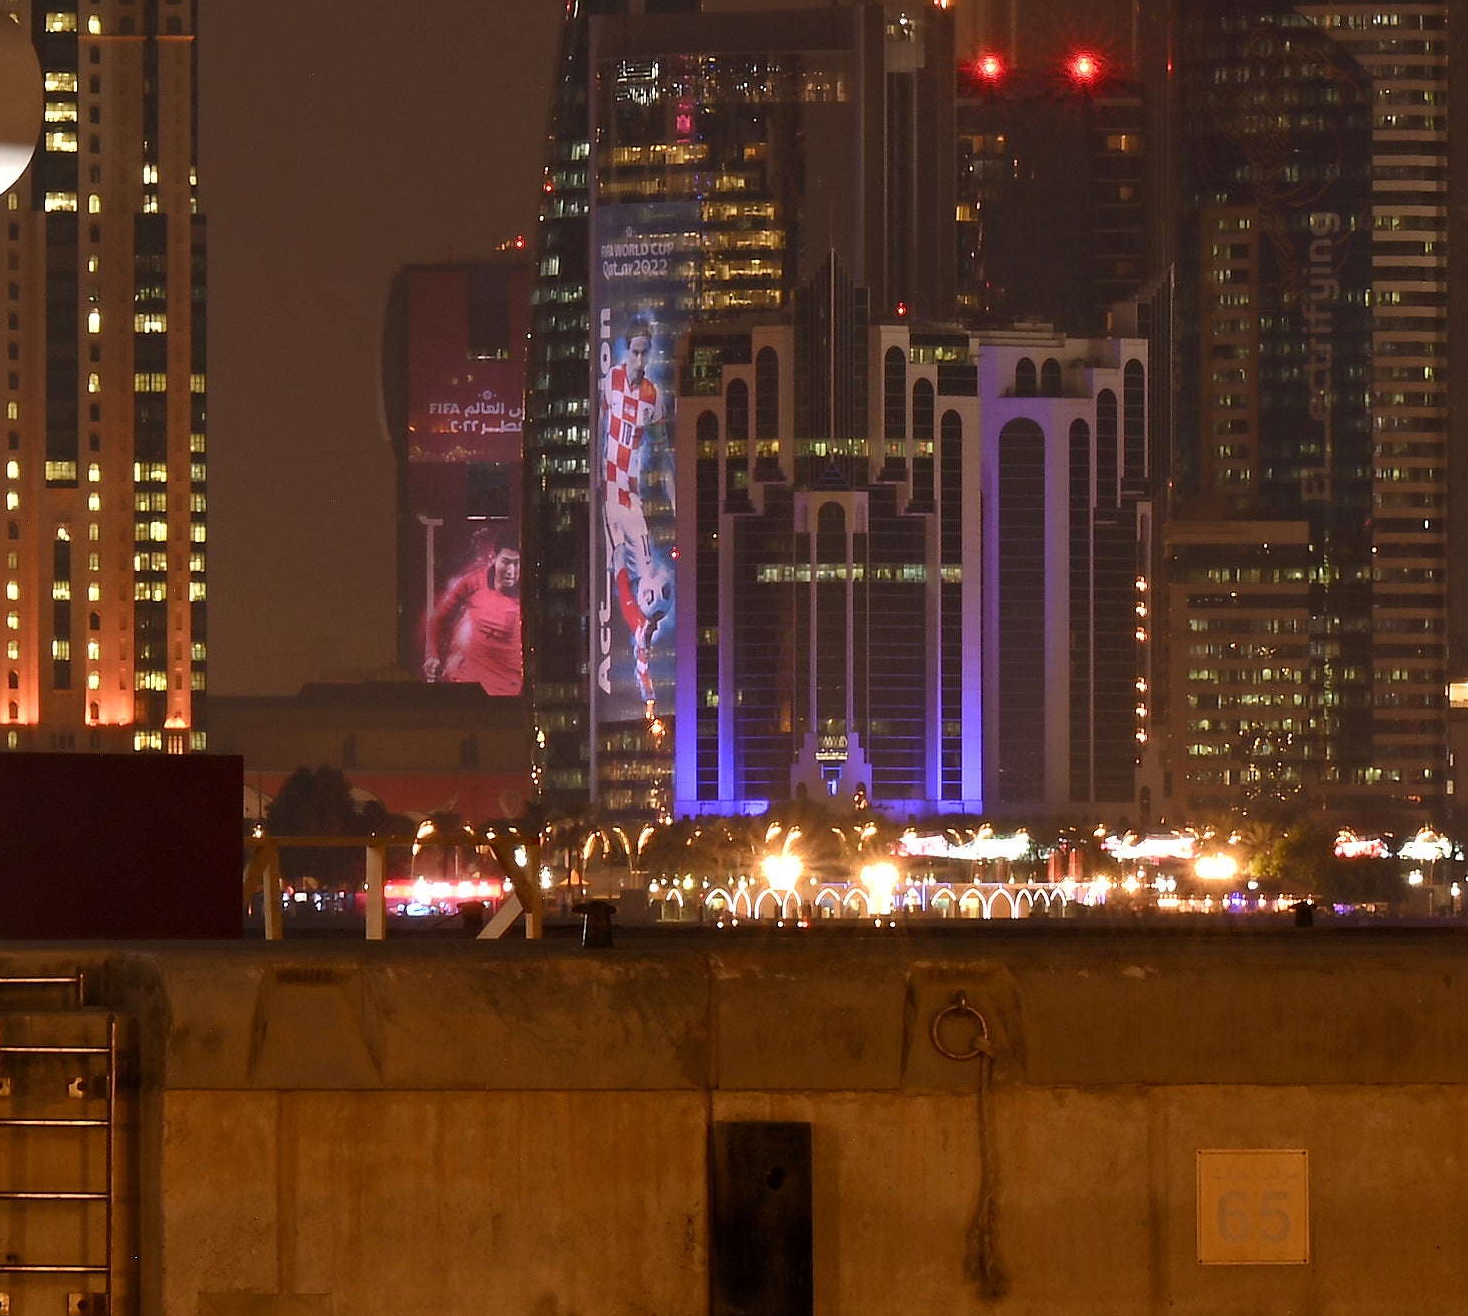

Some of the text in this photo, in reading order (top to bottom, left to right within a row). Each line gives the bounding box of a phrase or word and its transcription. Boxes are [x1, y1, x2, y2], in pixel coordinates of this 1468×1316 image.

[615, 243, 650, 257] WORLD
[651, 242, 675, 256] CUP
[428, 402, 461, 415] FIFA
[464, 402, 505, 418] العالم
